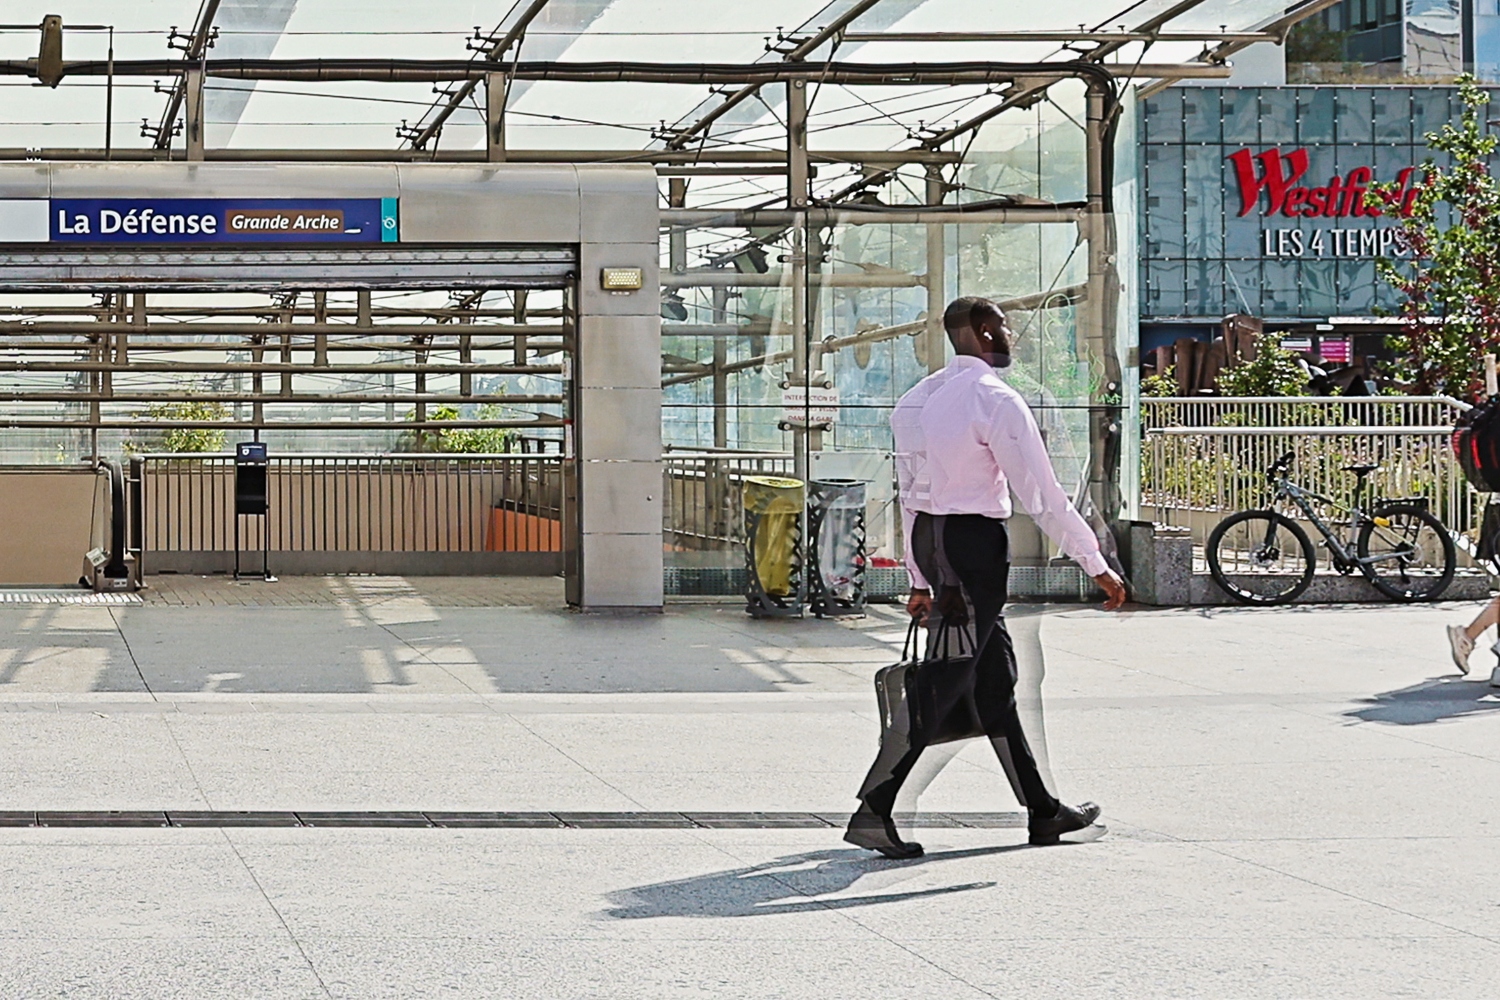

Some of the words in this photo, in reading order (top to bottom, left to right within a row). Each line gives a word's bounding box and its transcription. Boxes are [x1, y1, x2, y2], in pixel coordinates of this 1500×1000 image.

[58, 209, 90, 234] La
[100, 208, 217, 234] Défense
[231, 214, 289, 231] Grande
[293, 214, 339, 230] Arche
[1265, 228, 1304, 257] LES
[1311, 228, 1325, 257] 4
